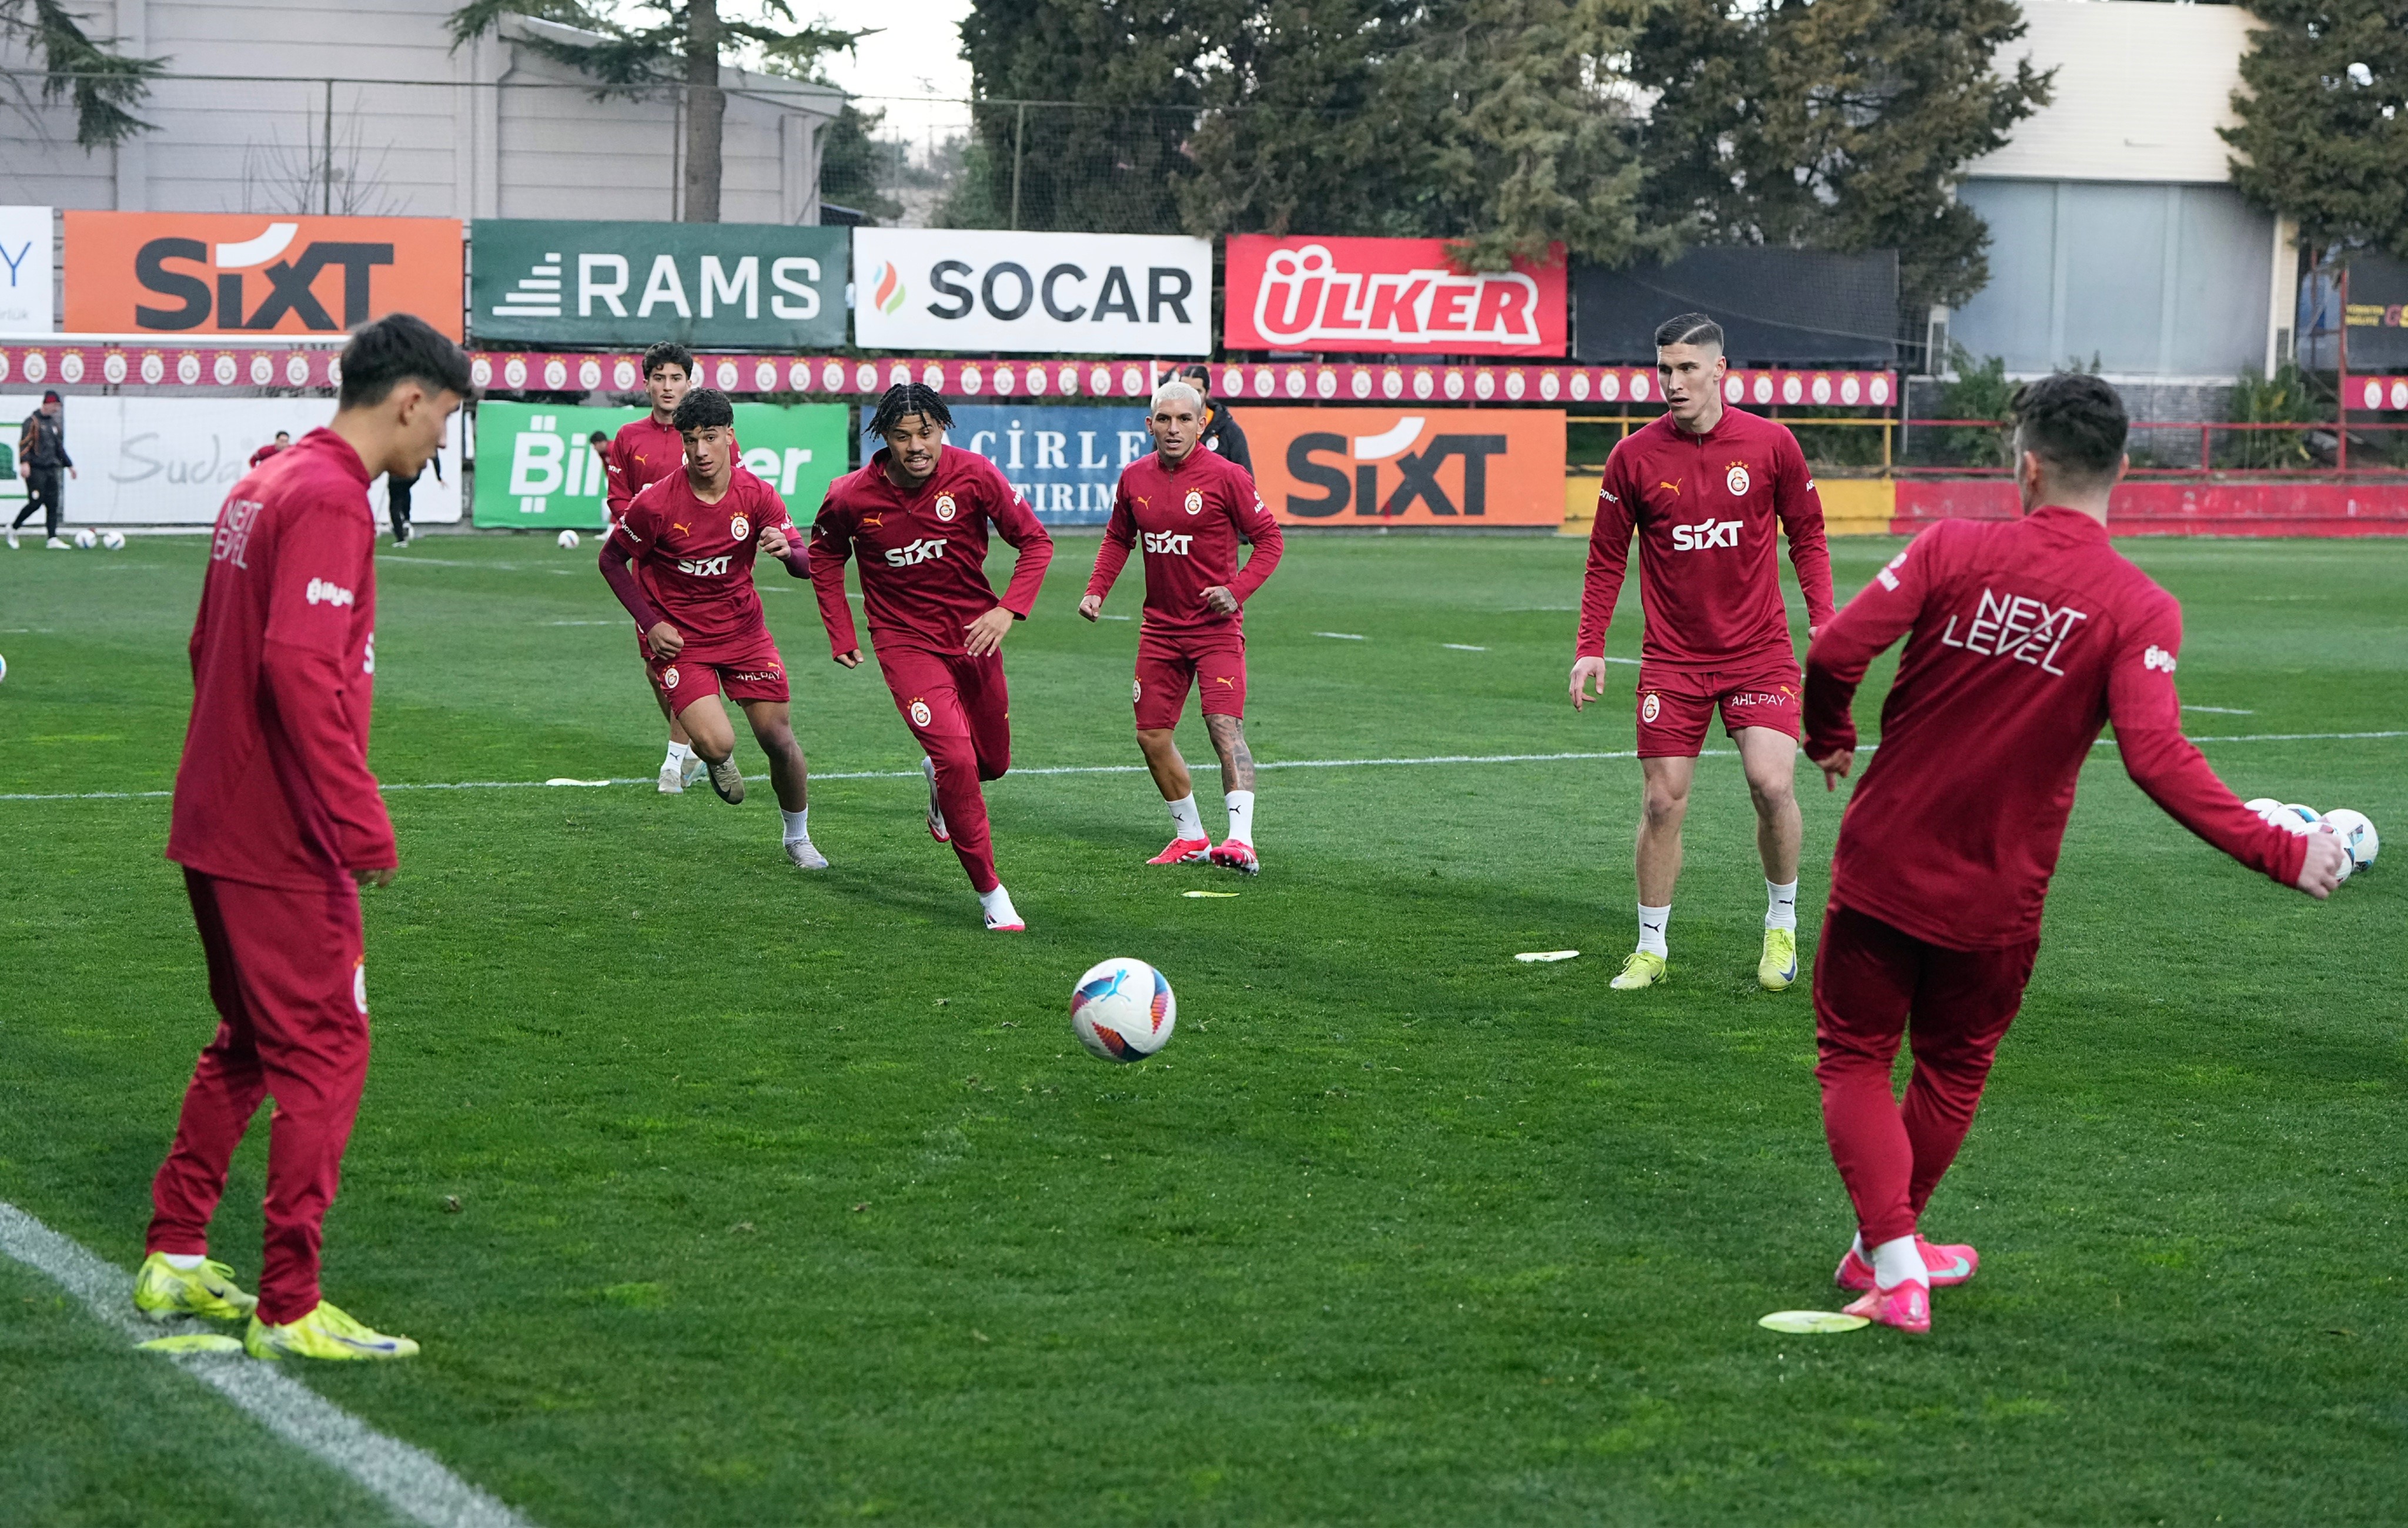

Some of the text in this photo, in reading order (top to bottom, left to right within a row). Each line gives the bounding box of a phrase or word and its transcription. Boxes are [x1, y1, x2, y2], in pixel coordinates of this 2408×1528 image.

[135, 223, 394, 331] SIXT
[578, 253, 821, 319] RAMS
[927, 260, 1192, 323] SOCAR
[1253, 245, 1541, 345] ÜLKER
[1286, 417, 1507, 517] SIXT
[1599, 489, 1618, 504] oner
[1941, 614, 2065, 677] LEVEL
[1976, 588, 2088, 641] NEXT
